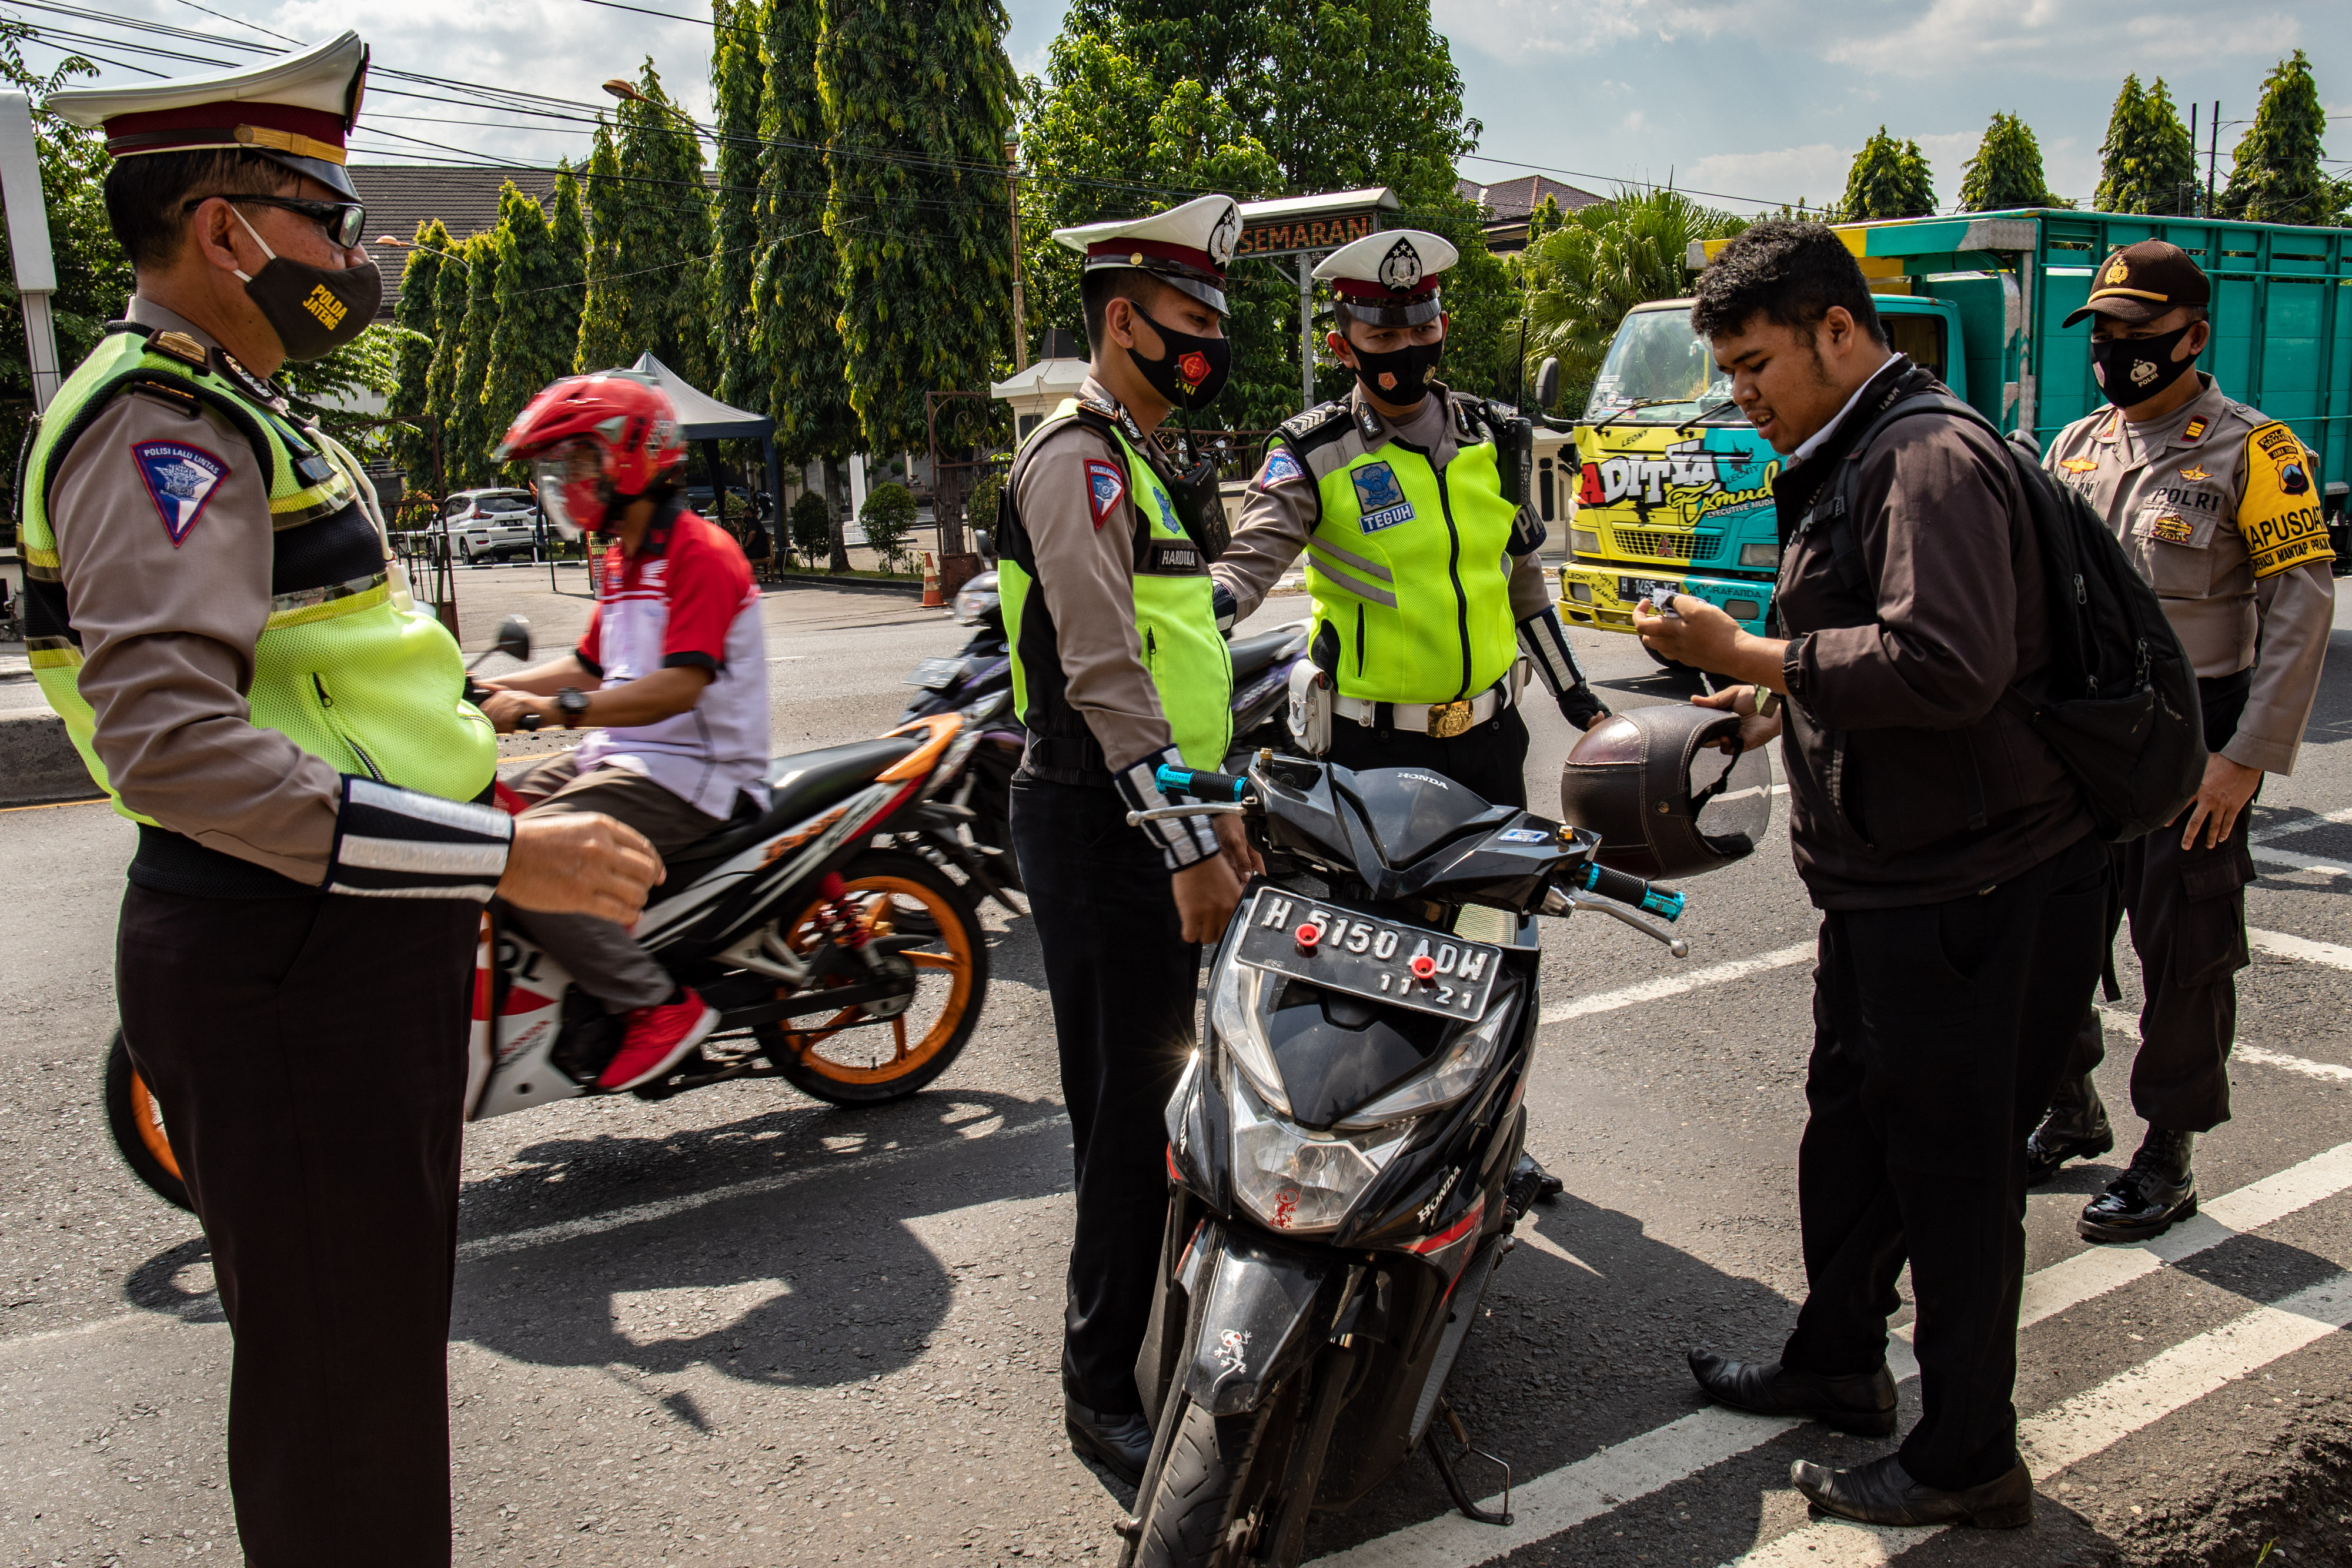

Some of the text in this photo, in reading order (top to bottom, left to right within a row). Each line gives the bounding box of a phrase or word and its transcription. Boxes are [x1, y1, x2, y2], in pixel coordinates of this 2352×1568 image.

[311, 284, 348, 320] POLDA
[303, 297, 339, 330] JATENG
[2137, 373, 2159, 387] POLRI
[1285, 422, 1302, 435] POLISI
[1621, 427, 1649, 447] LEONY
[144, 447, 220, 474] POLISI LALU LINTAS
[2271, 449, 2285, 457] JAWA
[1578, 440, 1716, 504] ADITYA
[2152, 487, 2219, 511] POLRI
[1364, 506, 1411, 530] TEGUH
[1707, 503, 1749, 519] EXECUTIVE
[1162, 550, 1195, 566] HARDIKA
[2276, 542, 2308, 563] MANTAP
[1567, 572, 1591, 581] LEONY
[1621, 577, 1628, 593] H
[1591, 583, 1619, 606] EXMUD
[1164, 771, 1190, 780] MONSTER
[1397, 772, 1449, 790] HONDA
[1264, 898, 1293, 930] H
[1310, 909, 1399, 959] 5150
[1417, 1166, 1461, 1223] HONDA
